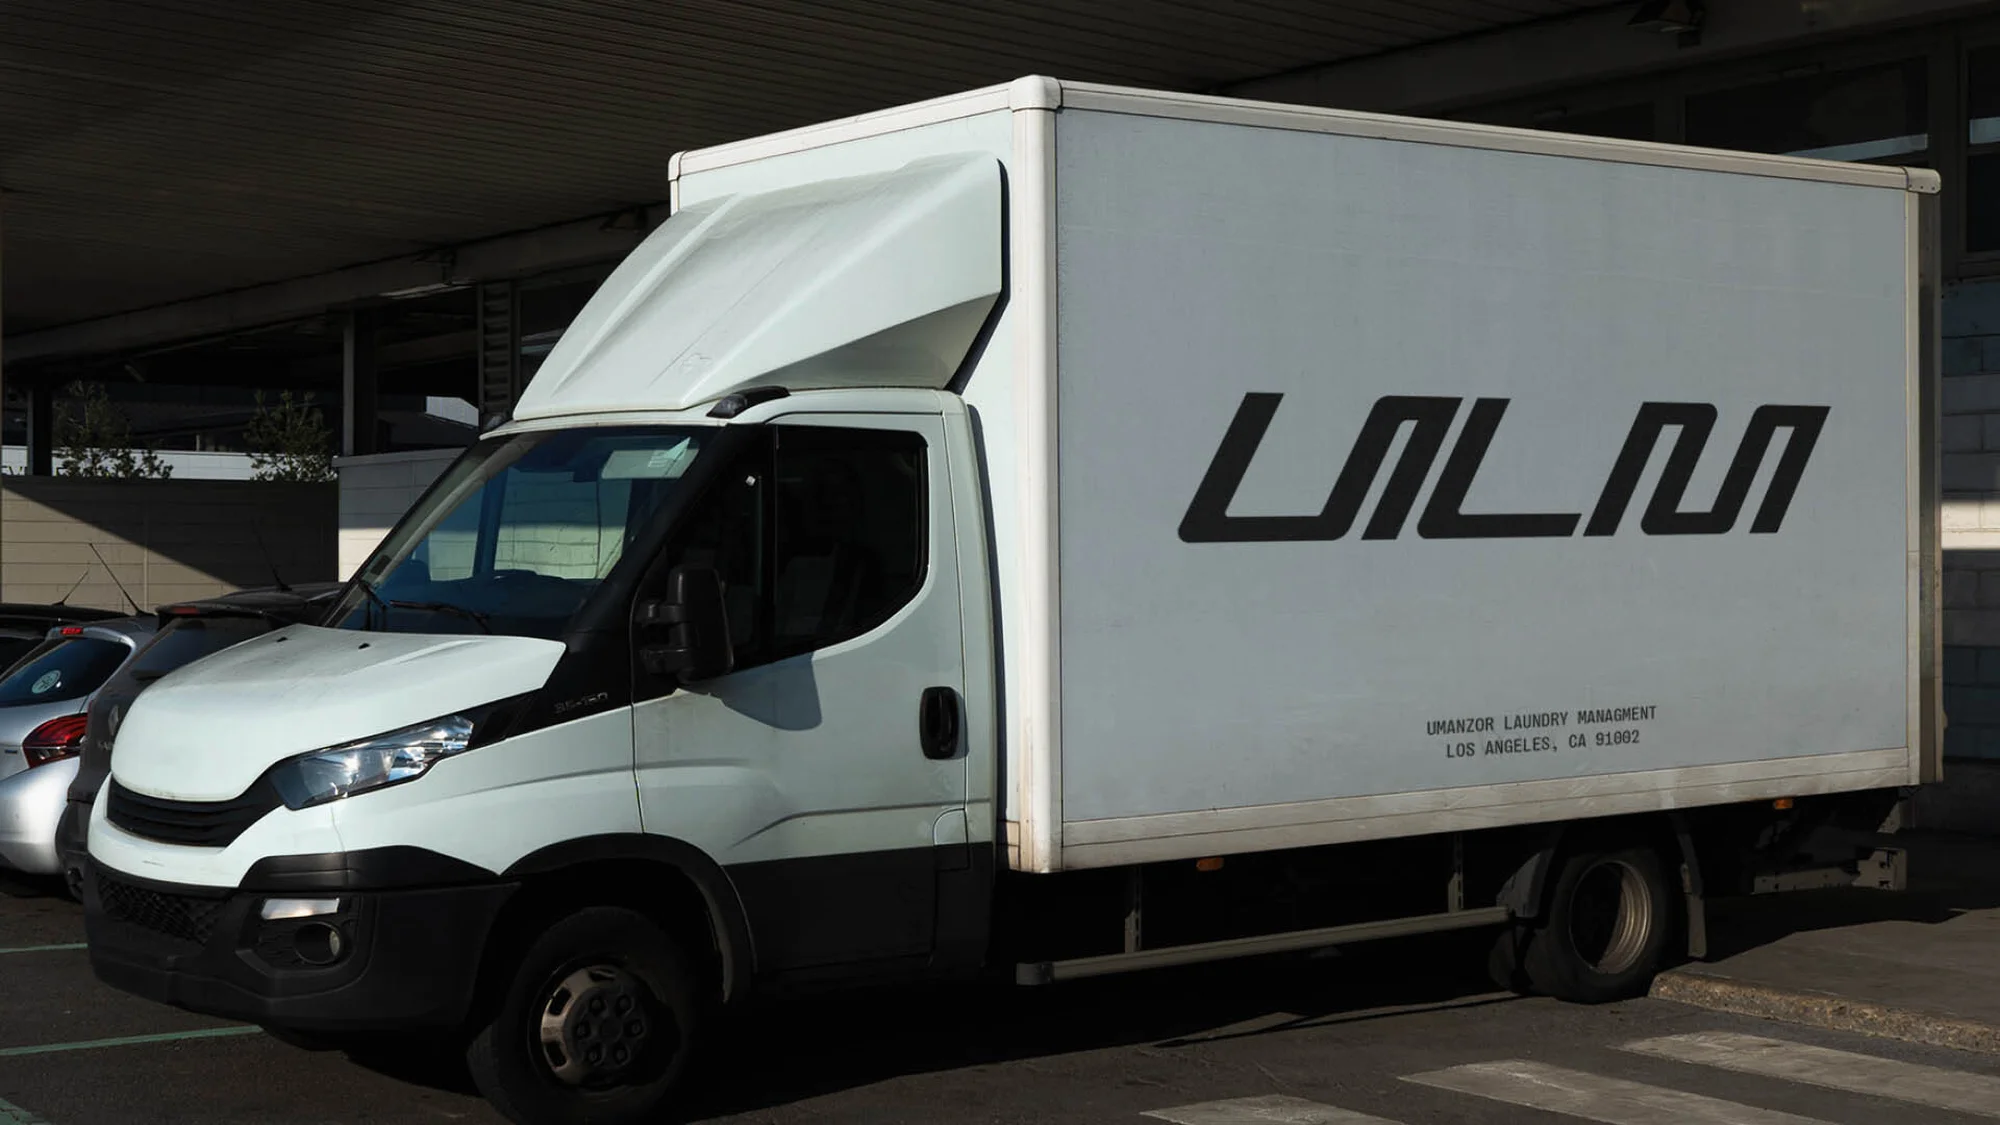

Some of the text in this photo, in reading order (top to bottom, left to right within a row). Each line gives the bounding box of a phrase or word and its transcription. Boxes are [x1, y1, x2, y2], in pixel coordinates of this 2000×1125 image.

[1426, 705, 1657, 735] UMANZOR LAUNDRY MANAGMENT
[1446, 729, 1641, 759] LOS ANGELES, CA 91002
